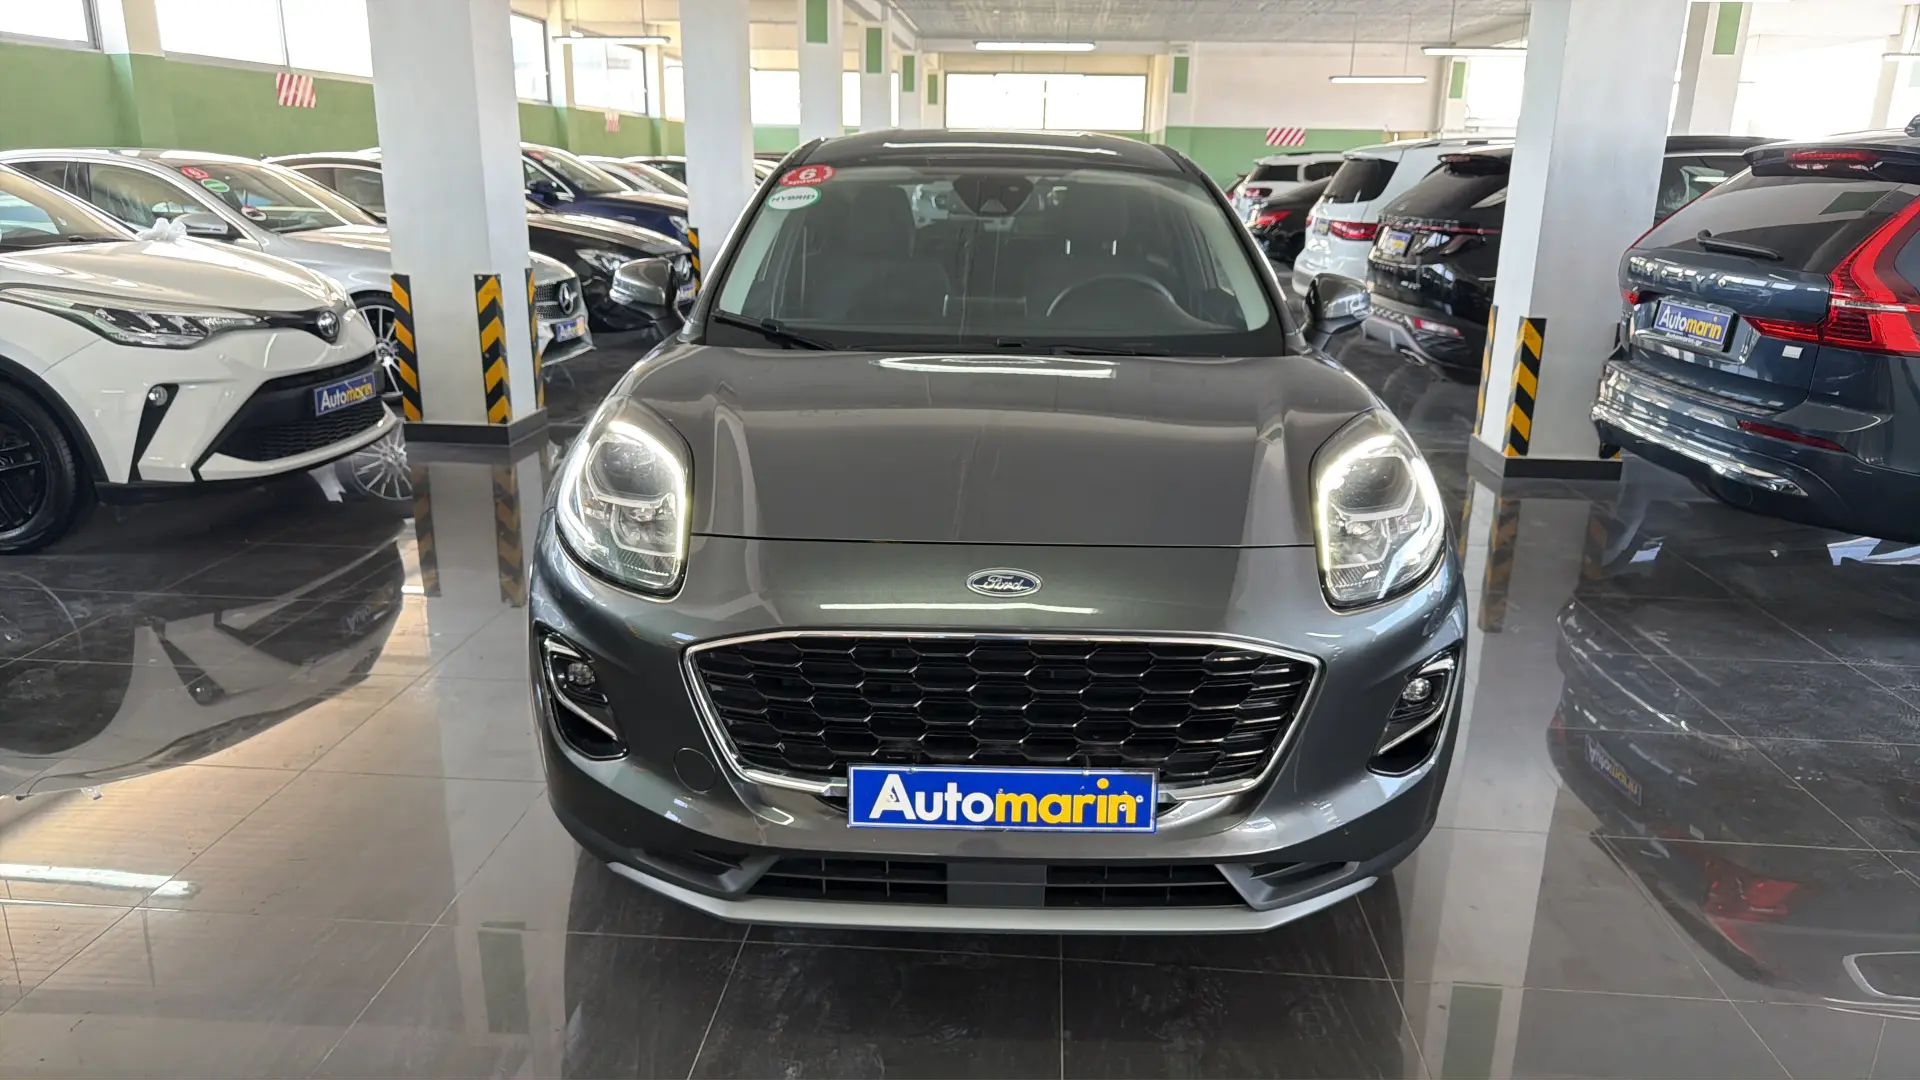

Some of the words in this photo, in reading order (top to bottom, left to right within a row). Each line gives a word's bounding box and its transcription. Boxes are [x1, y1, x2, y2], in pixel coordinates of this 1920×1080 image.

[799, 168, 817, 180] 6
[771, 194, 816, 203] HYBRID
[1658, 305, 1723, 341] Automarin
[320, 377, 373, 412] Automarin
[972, 575, 1030, 591] Ford
[869, 773, 1137, 824] Automarin
